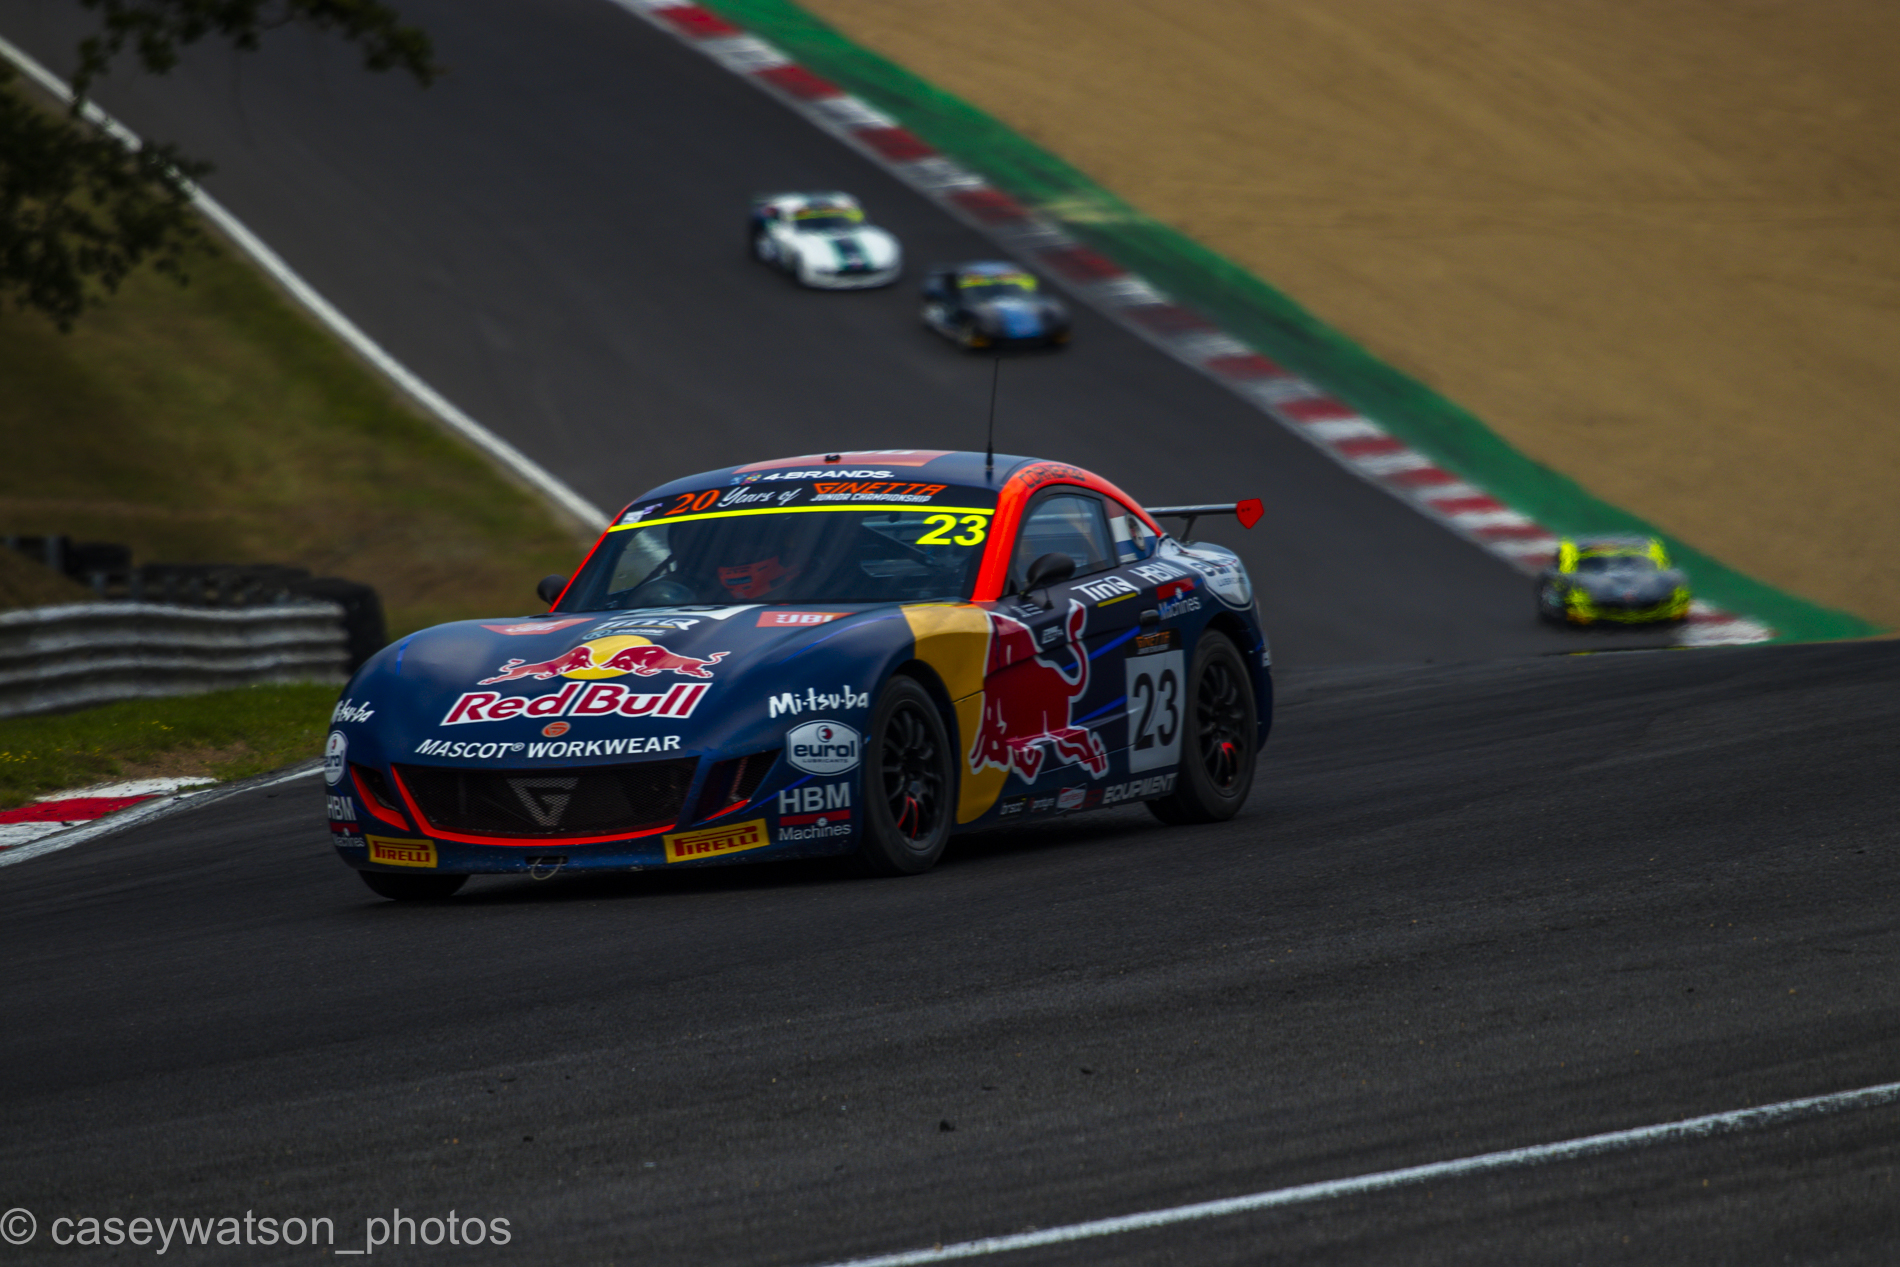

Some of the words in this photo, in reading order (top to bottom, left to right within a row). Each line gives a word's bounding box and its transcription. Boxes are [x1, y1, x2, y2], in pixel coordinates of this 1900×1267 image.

[810, 493, 852, 502] JUNIOR
[850, 493, 932, 503] CHAMPIONSHIP
[813, 482, 948, 496] GINETTA
[664, 489, 721, 516] 20
[717, 487, 777, 507] Years
[777, 487, 802, 506] of
[915, 513, 988, 547] 23
[1128, 562, 1187, 584] HBM
[1158, 596, 1202, 620] Machines
[439, 681, 586, 727] Red
[566, 682, 713, 719] Bull
[1132, 668, 1178, 751] 23
[527, 735, 682, 758] WORKWEAR
[793, 740, 856, 758] eurol
[326, 795, 357, 821] HBM
[778, 782, 851, 815] HBM
[673, 825, 759, 857] PIRELLI
[778, 823, 851, 841] Machines
[373, 840, 430, 862] PIRELLI
